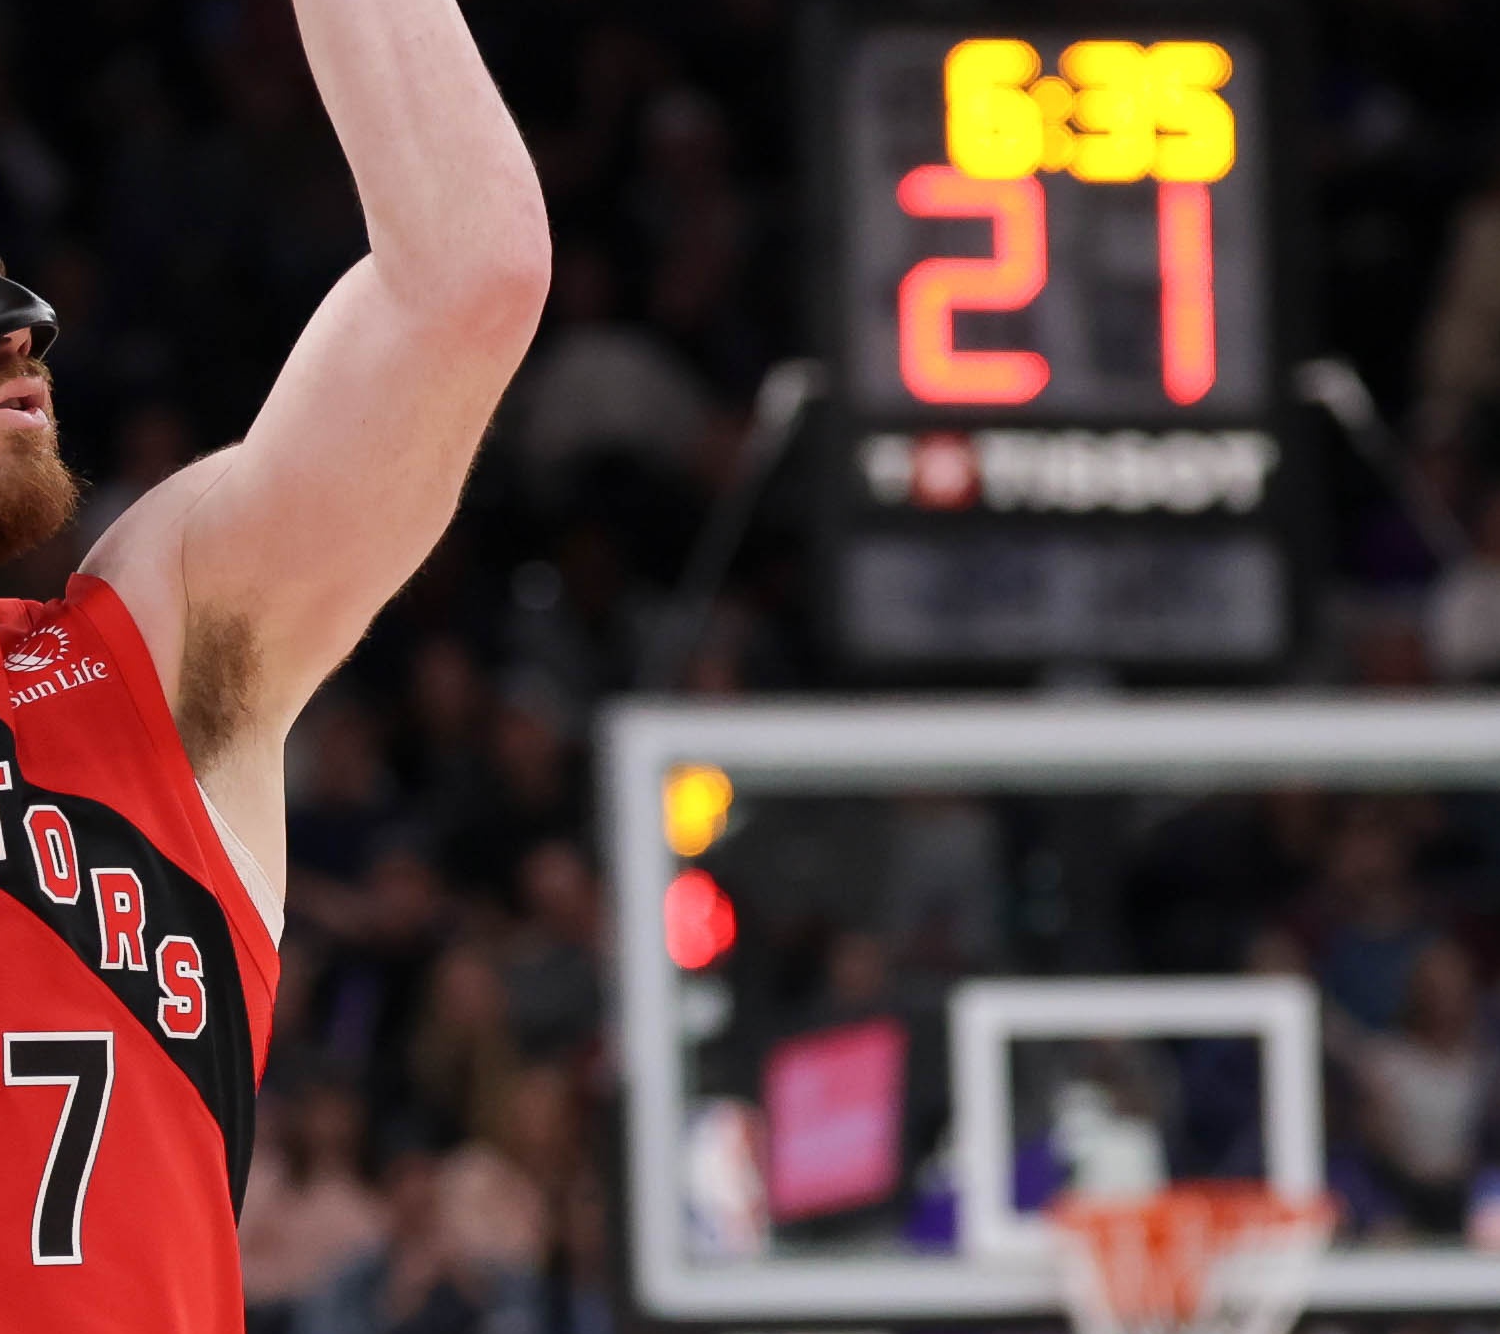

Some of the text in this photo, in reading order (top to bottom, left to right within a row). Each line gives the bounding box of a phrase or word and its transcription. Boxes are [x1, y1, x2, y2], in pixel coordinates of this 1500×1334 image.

[945, 38, 1236, 183] 6:35
[898, 164, 1216, 406] 21
[54, 657, 109, 690] Life
